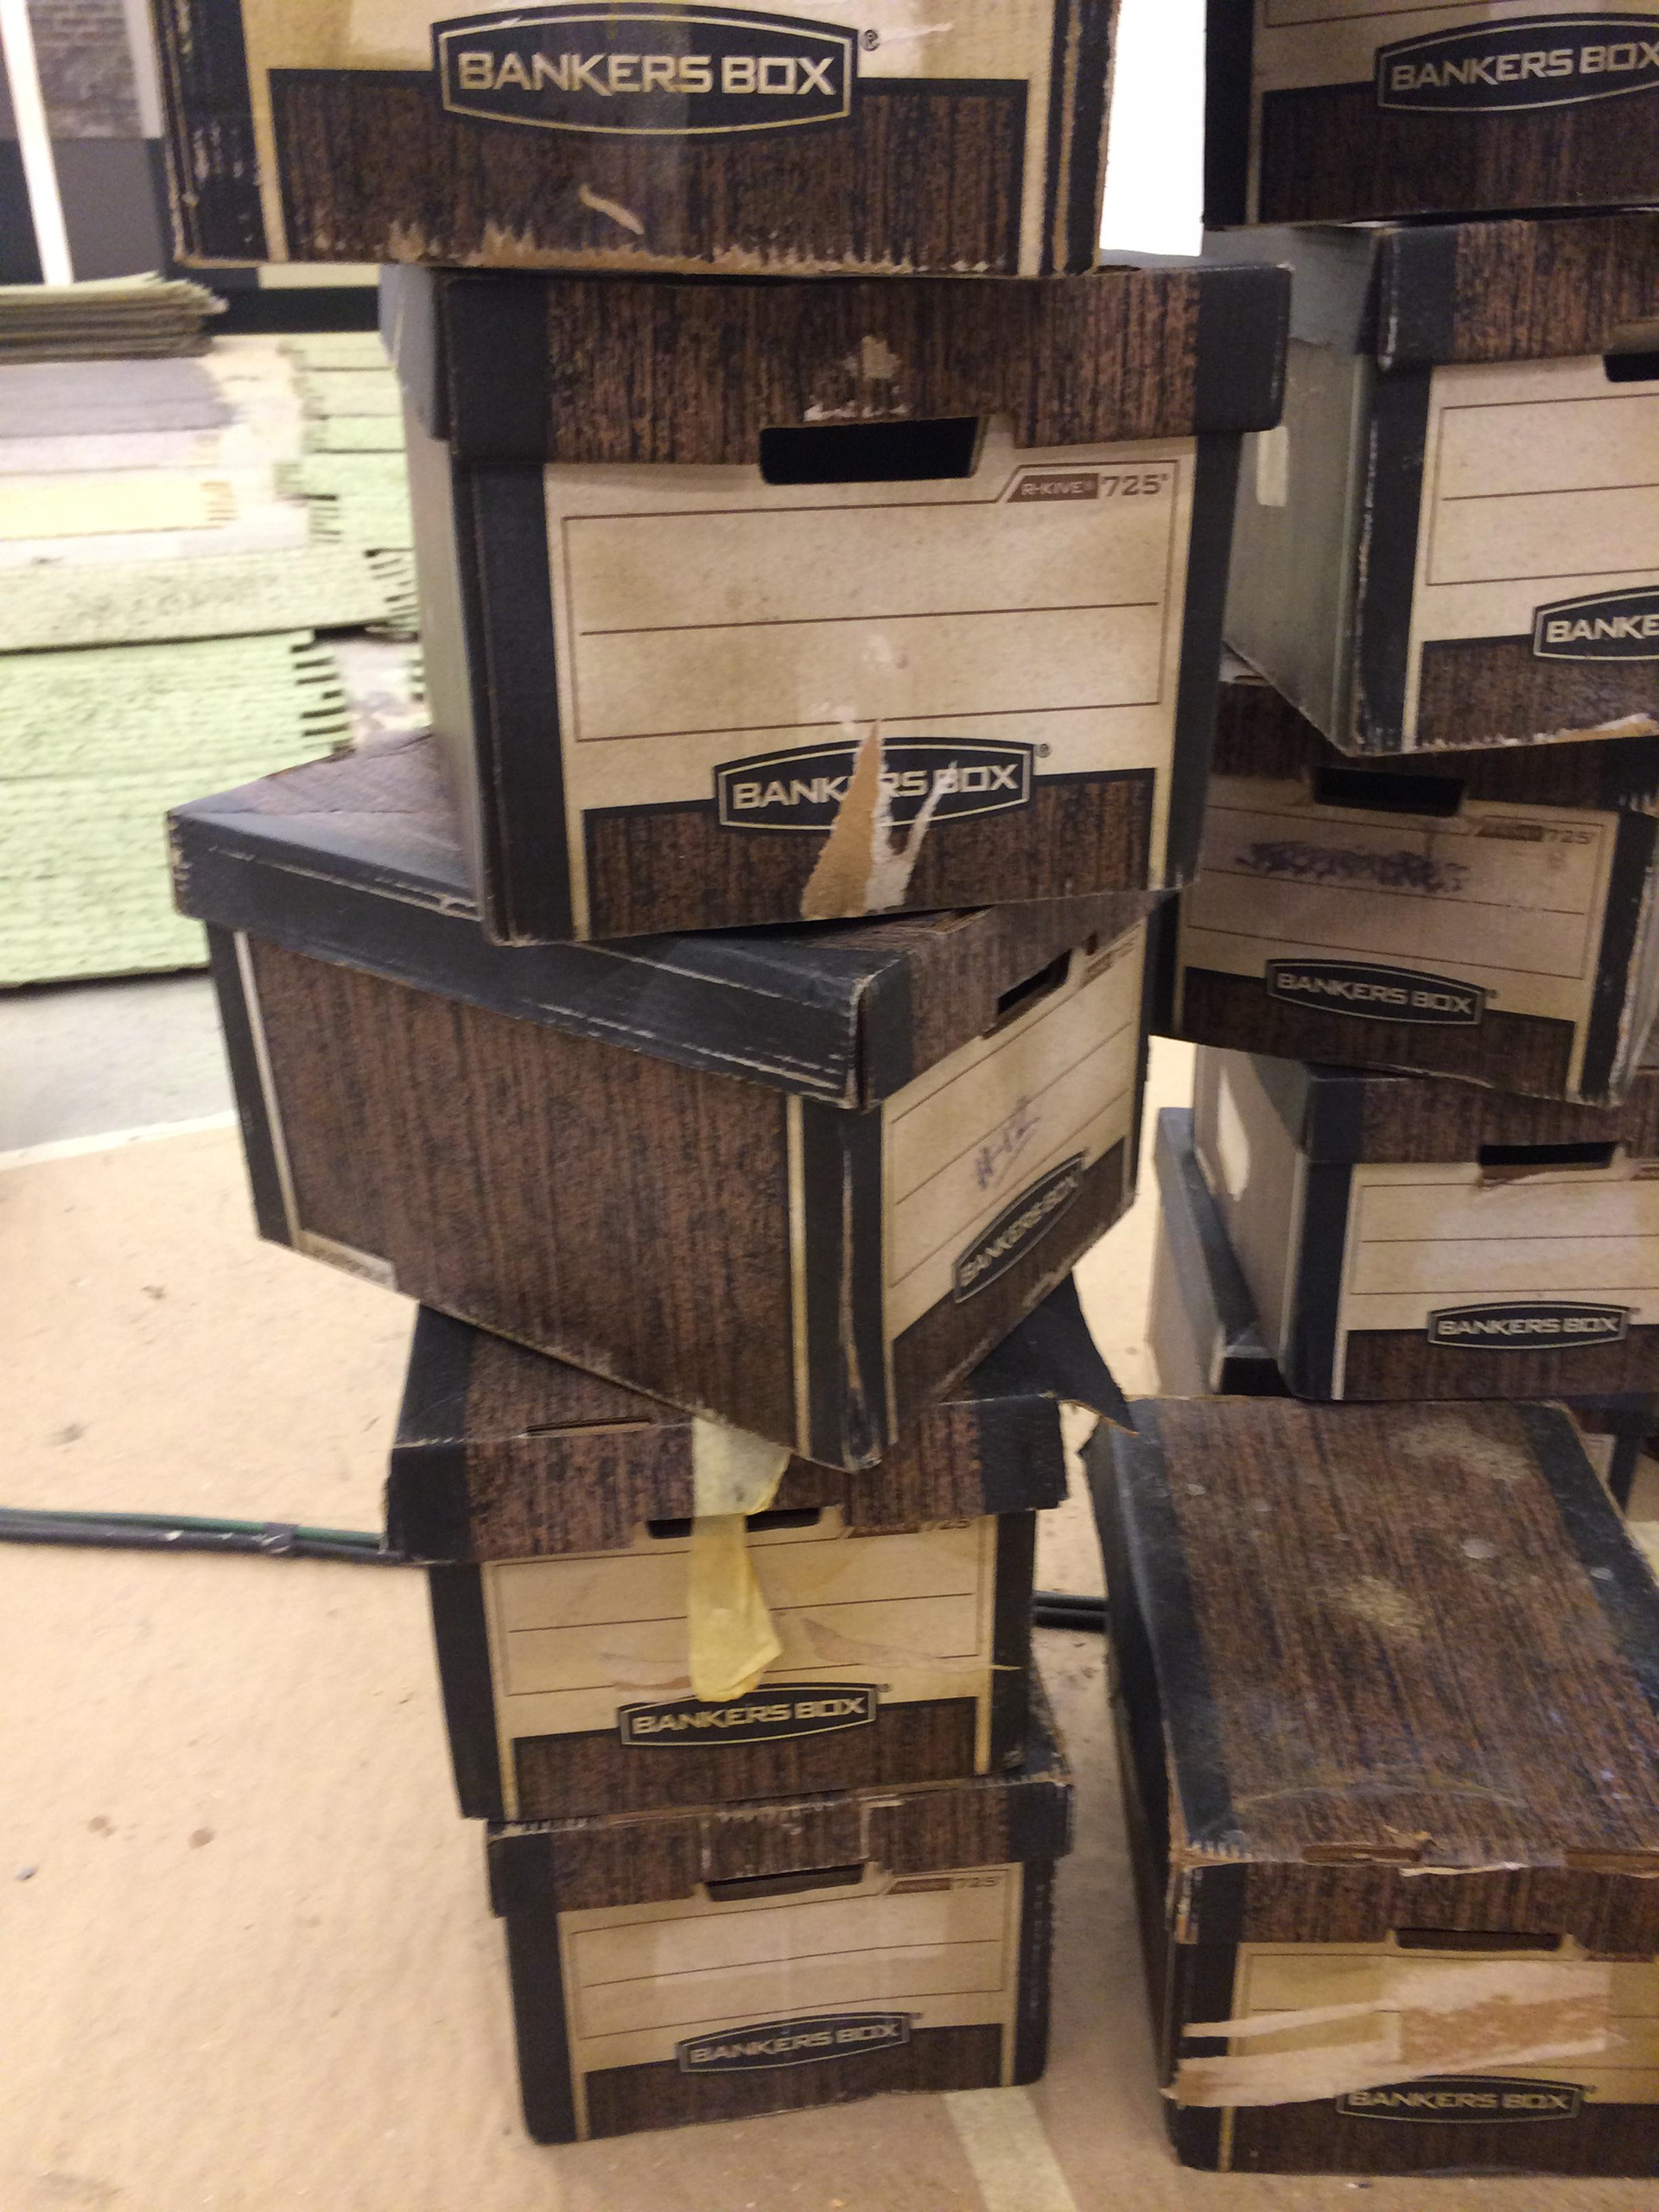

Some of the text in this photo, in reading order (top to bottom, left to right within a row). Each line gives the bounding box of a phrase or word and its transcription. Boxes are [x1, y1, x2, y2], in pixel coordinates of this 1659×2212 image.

[458, 52, 836, 96] BANKERS BOX
[1390, 48, 1574, 92] BANKERS
[733, 770, 929, 810] BANKRS
[1275, 972, 1474, 1014] BANKERS BOX
[1438, 1317, 1619, 1336] BANKERS BOX
[632, 1697, 867, 1735] BANKERS BOX
[690, 2023, 900, 2063] BANKERS BOX
[1347, 2090, 1572, 2110] BANKERS BOX
